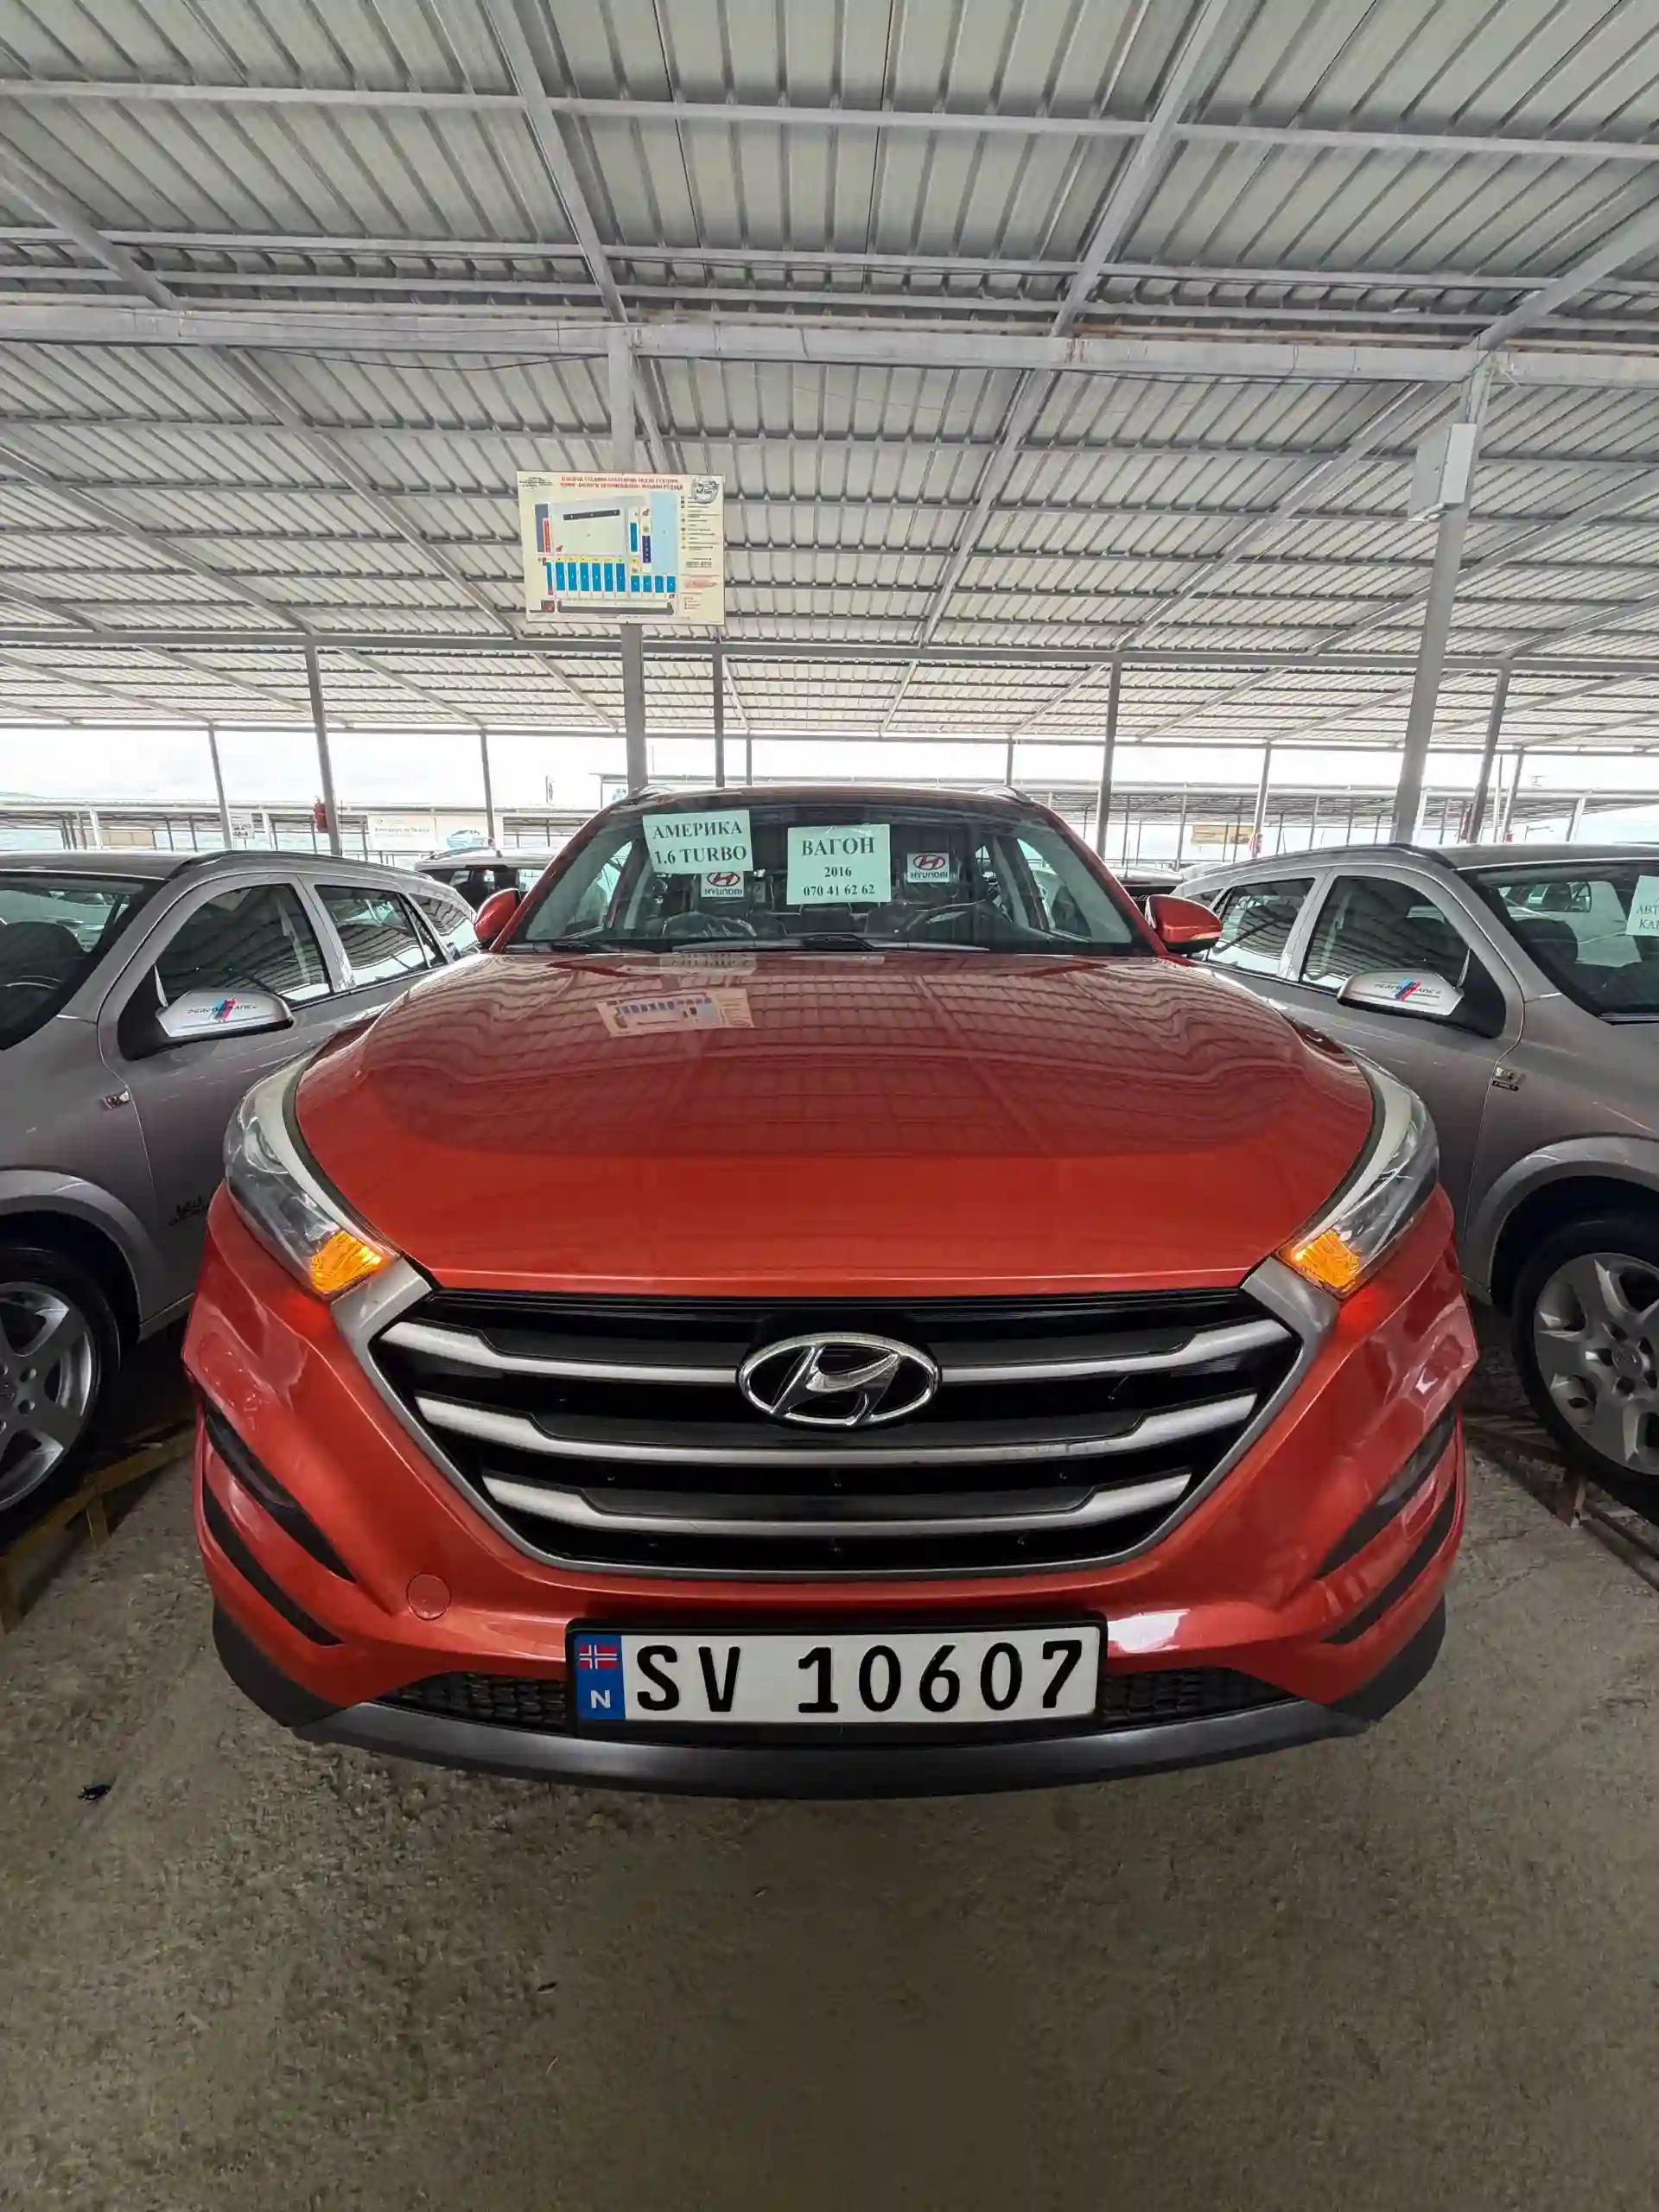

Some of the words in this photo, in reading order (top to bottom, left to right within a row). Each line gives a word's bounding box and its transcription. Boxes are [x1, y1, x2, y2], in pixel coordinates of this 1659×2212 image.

[653, 820, 742, 840] АМЕРИКА
[654, 849, 676, 864] 1.6
[680, 846, 747, 863] TURBO
[802, 836, 874, 856] ВАГОН
[824, 866, 852, 877] 2016
[910, 870, 948, 879] HYUNDAI
[804, 885, 823, 896] 070
[827, 885, 839, 896] 41
[844, 884, 858, 895] 62
[861, 884, 875, 894] 62
[637, 1644, 741, 1713] SV
[798, 1639, 1082, 1713] 10607
[590, 1689, 611, 1709] N
